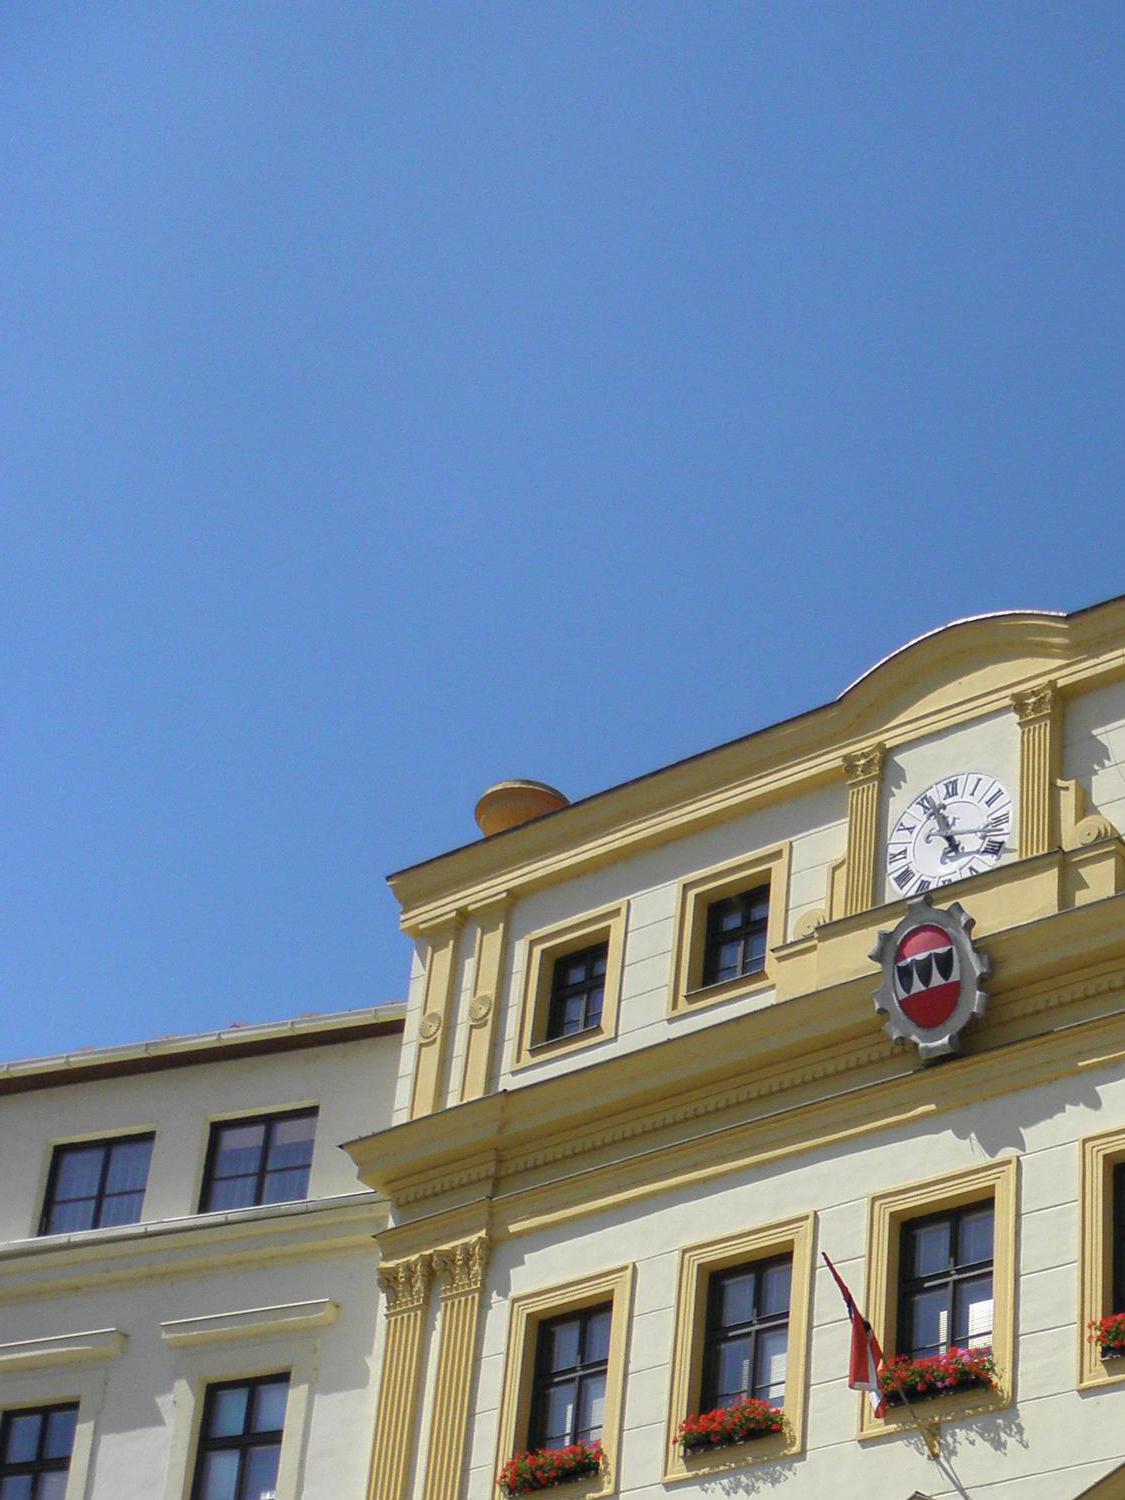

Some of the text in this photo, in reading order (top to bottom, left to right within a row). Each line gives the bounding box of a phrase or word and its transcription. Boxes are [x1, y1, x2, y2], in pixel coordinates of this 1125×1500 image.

[943, 778, 959, 800] XII
[985, 788, 1004, 807] II
[896, 822, 916, 835] X
[888, 847, 908, 865] IX
